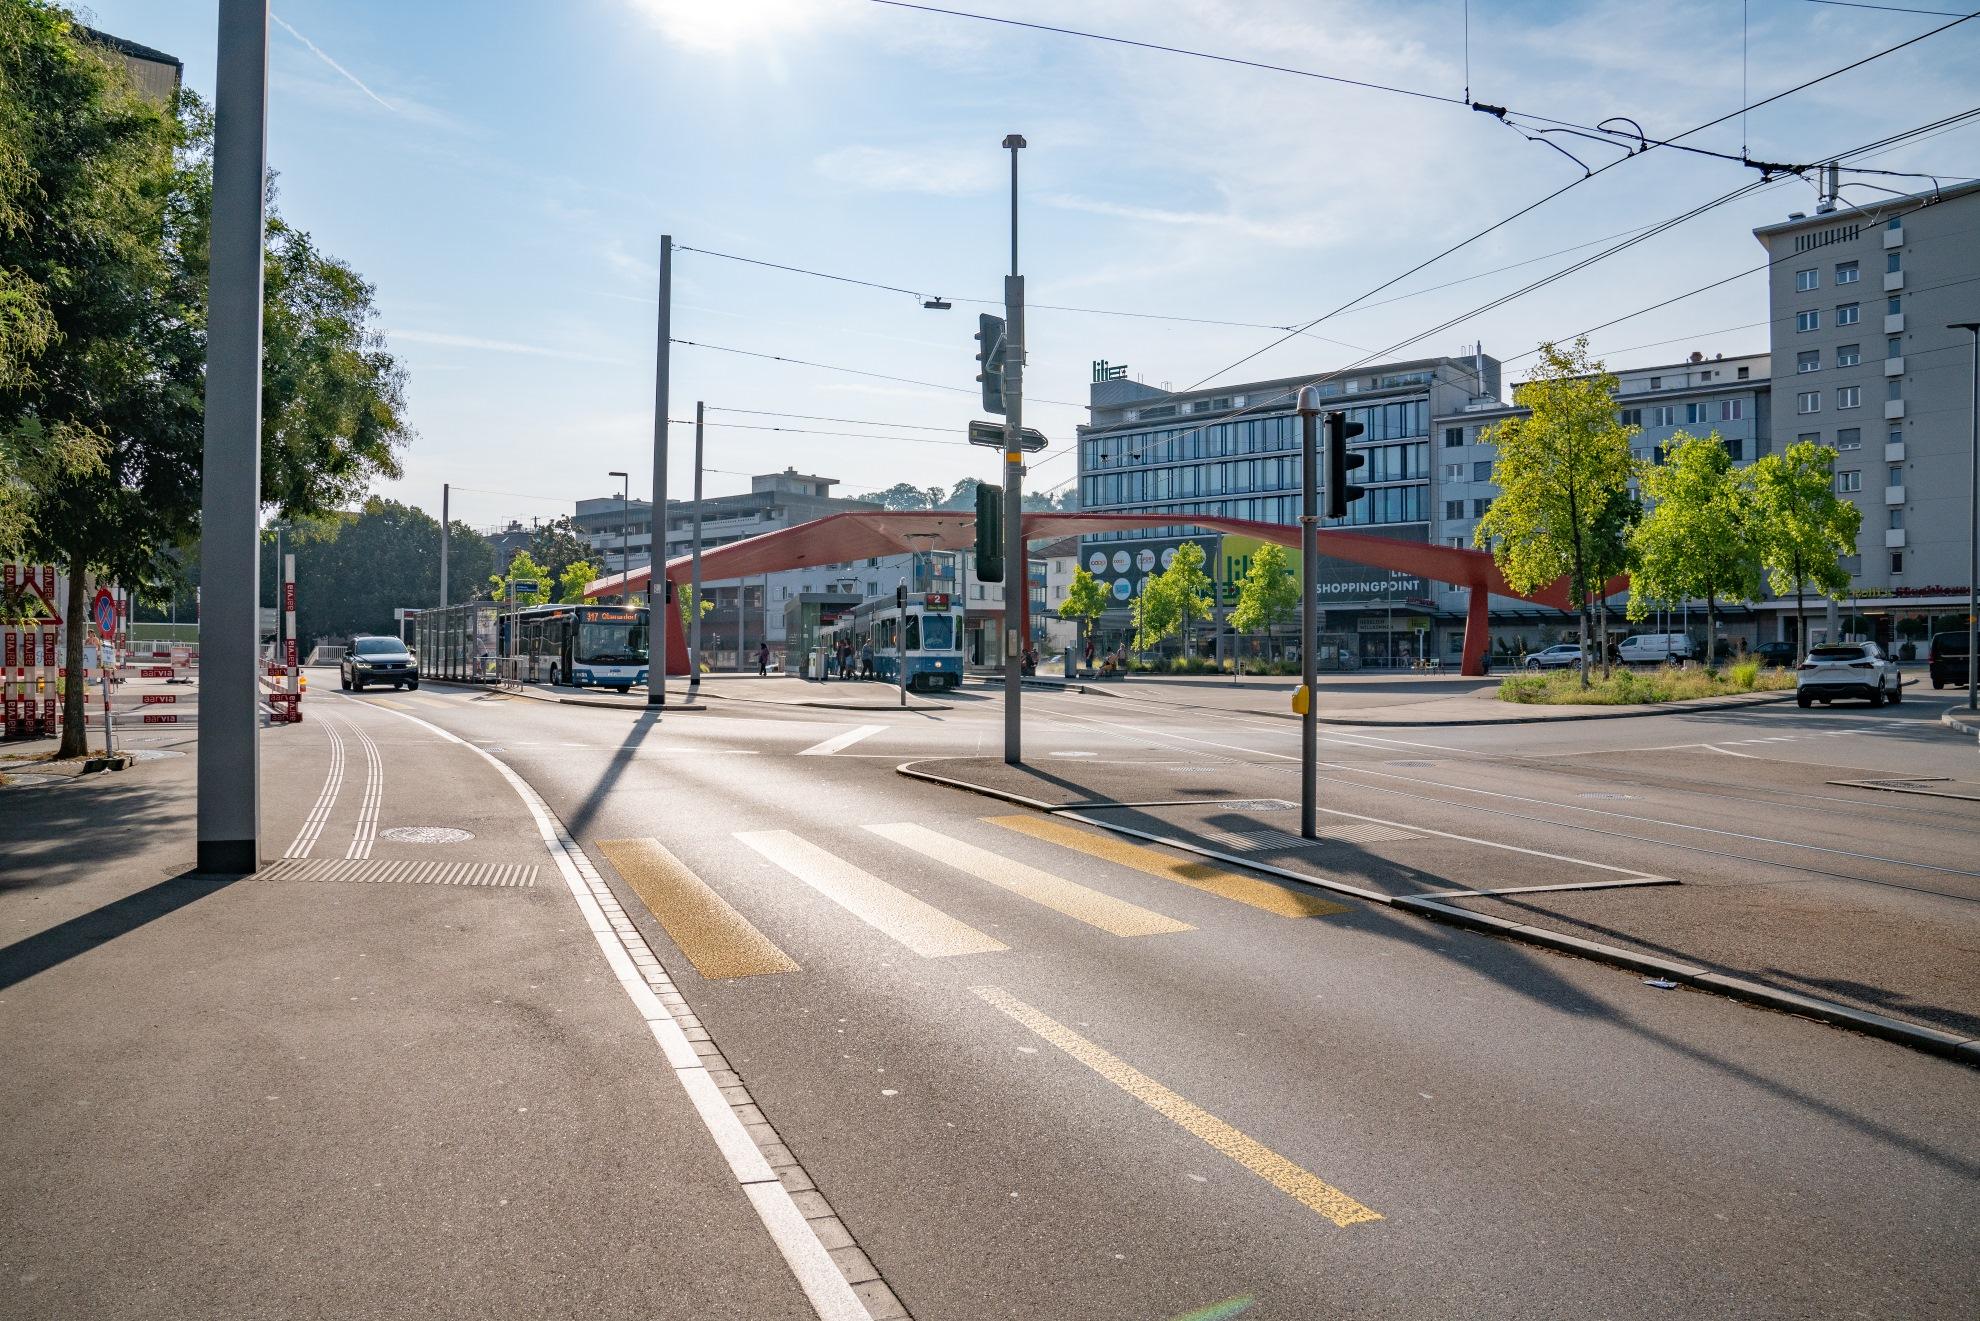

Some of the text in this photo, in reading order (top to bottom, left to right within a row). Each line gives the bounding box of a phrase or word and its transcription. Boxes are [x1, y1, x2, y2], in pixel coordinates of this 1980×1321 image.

[1316, 580, 1420, 594] SHOPPINGPOINT
[934, 595, 941, 603] 2
[7, 634, 15, 666] aarvia
[25, 634, 34, 666] aarvia
[45, 634, 54, 666] aarvia
[144, 695, 174, 703] aarvia
[46, 700, 54, 731] aarvia
[145, 715, 176, 723] aarvia
